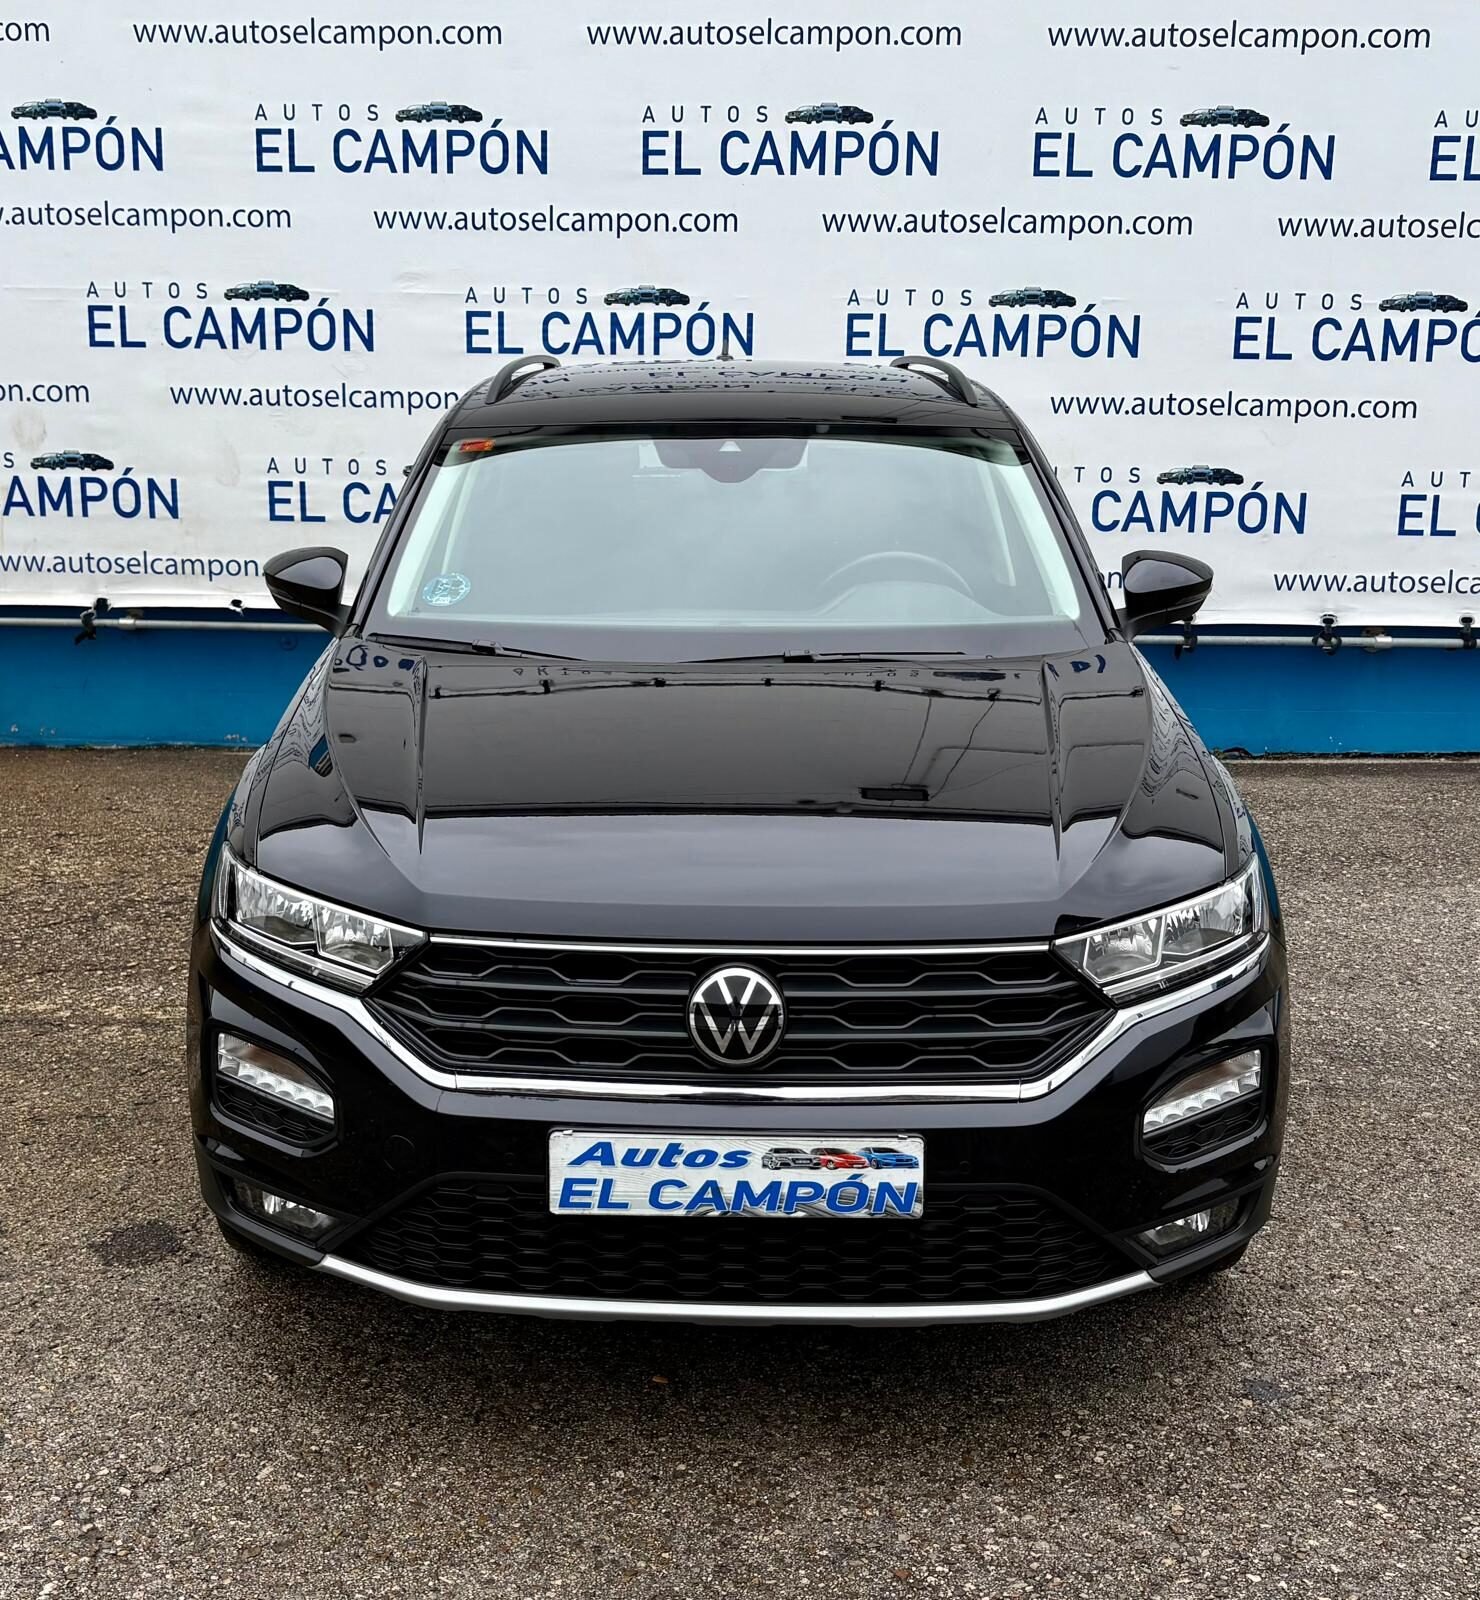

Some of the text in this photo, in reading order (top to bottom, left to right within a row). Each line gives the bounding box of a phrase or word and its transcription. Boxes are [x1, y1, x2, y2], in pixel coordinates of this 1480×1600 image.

[0, 23, 49, 41] om
[133, 18, 501, 51] www.autoselcampon.com
[587, 18, 961, 52] www.autoselcampon.com
[1048, 20, 1430, 55] www.autoselcampon.com
[255, 104, 378, 121] AUTOS
[643, 106, 767, 122] AUTOS
[1035, 107, 1162, 125] AUTOS
[256, 119, 547, 174] EL CAMPÓN
[642, 121, 938, 176] EL CAMPÓN
[1033, 124, 1335, 180] EL CAMPÓN
[1430, 136, 1480, 181] EL
[0, 201, 290, 233] .autoselcampon.com
[374, 205, 737, 238] www.autoselcampon.com
[823, 207, 1192, 240] www.autoselcampon.com
[1278, 212, 1480, 238] www.autoselc
[87, 282, 207, 299] AUTOS
[466, 287, 587, 304] AUTOS
[848, 289, 971, 306] AUTOS
[1236, 292, 1361, 310] AUTOS
[88, 298, 374, 352] EL CAMPÓN
[466, 302, 754, 357] EL CAMPÓN
[846, 305, 1140, 359] EL CAMPÓN
[1233, 317, 1292, 360] EL
[1051, 391, 1416, 423] www.autoselcampon.com
[267, 457, 386, 475] AUTOS
[1401, 471, 1470, 488] AUT
[3, 467, 179, 519] AMPÓN
[268, 481, 326, 522] EL
[1092, 483, 1307, 534] CAMPÓN
[1398, 494, 1456, 536] EL
[567, 1141, 752, 1169] Autos
[558, 1174, 919, 1216] EL CAMPÓN
